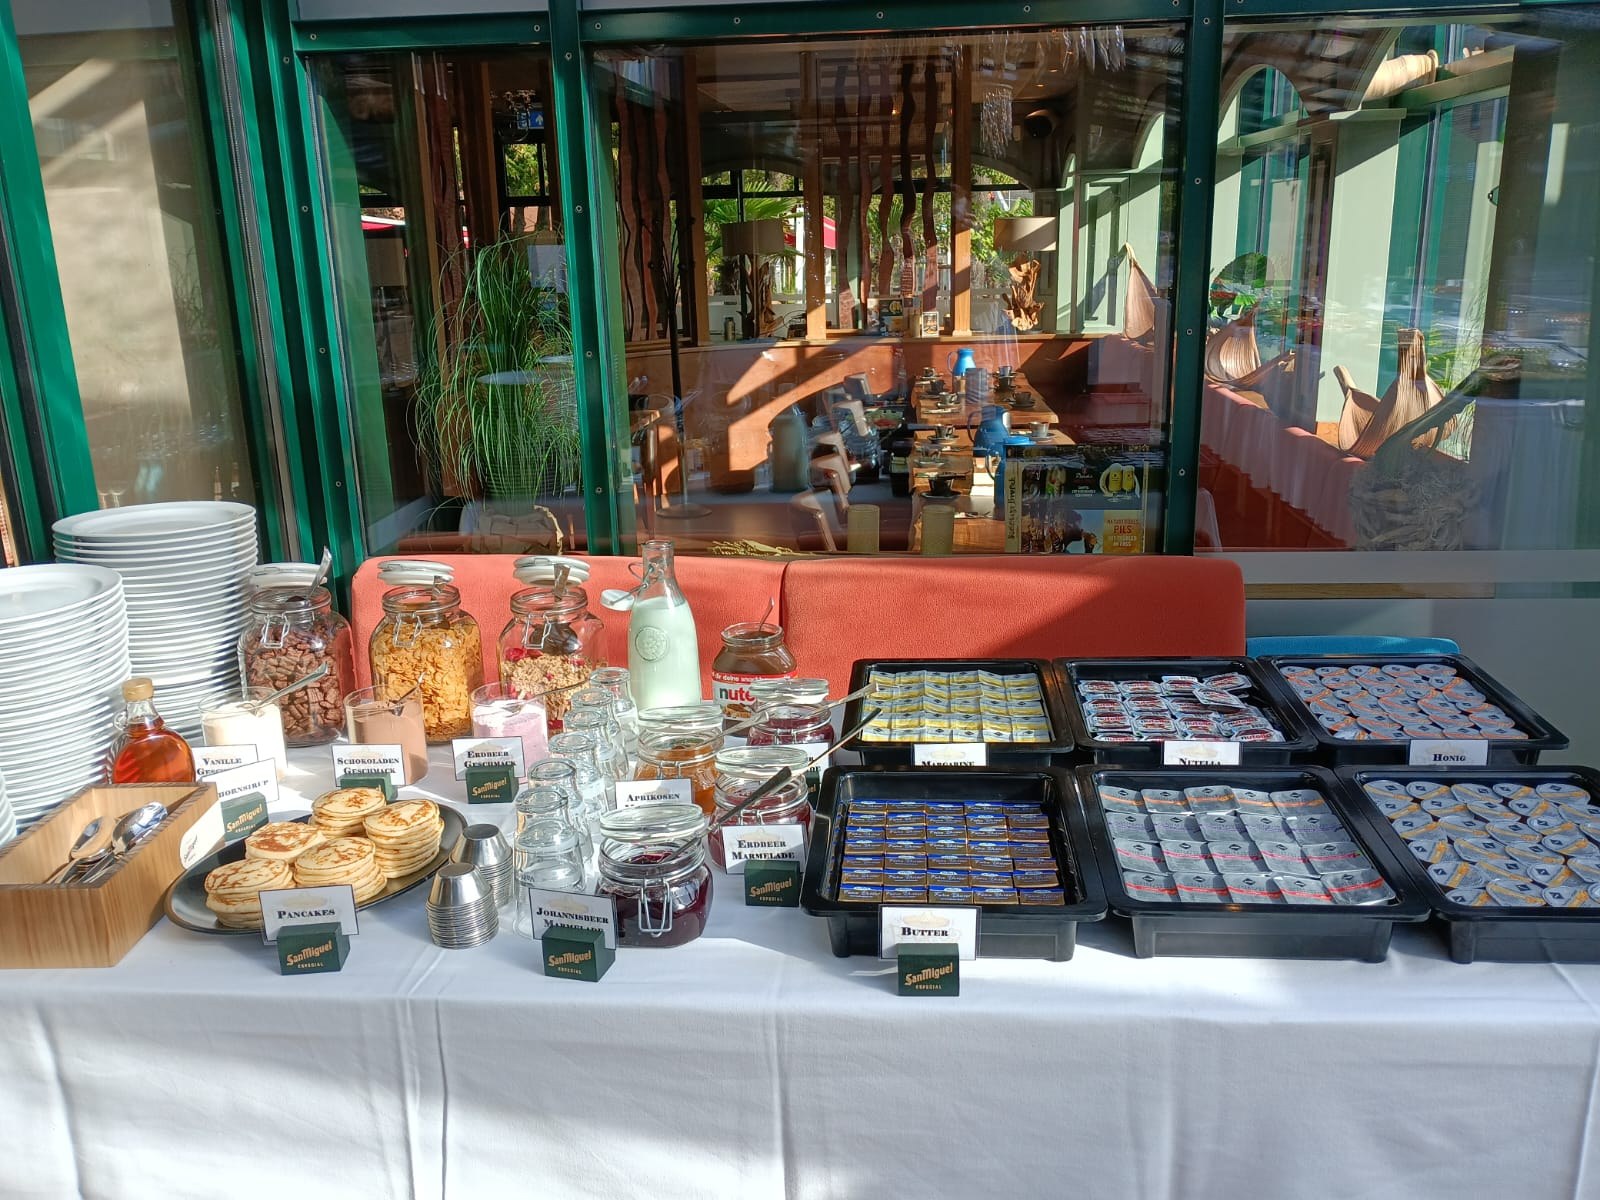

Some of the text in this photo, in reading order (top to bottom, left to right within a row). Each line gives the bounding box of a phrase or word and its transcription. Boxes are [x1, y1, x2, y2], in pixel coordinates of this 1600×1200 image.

[337, 757, 400, 765] SCHOKOLADEN
[1432, 753, 1466, 762] HONIG
[217, 779, 269, 798] HORNSIRUP
[627, 793, 680, 801] APRIKOSEN
[737, 839, 787, 849] ERDBEER
[731, 851, 796, 860] MARMELADE
[277, 909, 336, 919] PANCAKES
[536, 907, 609, 924] JOHANNISBEER
[901, 926, 949, 937] BUTTER
